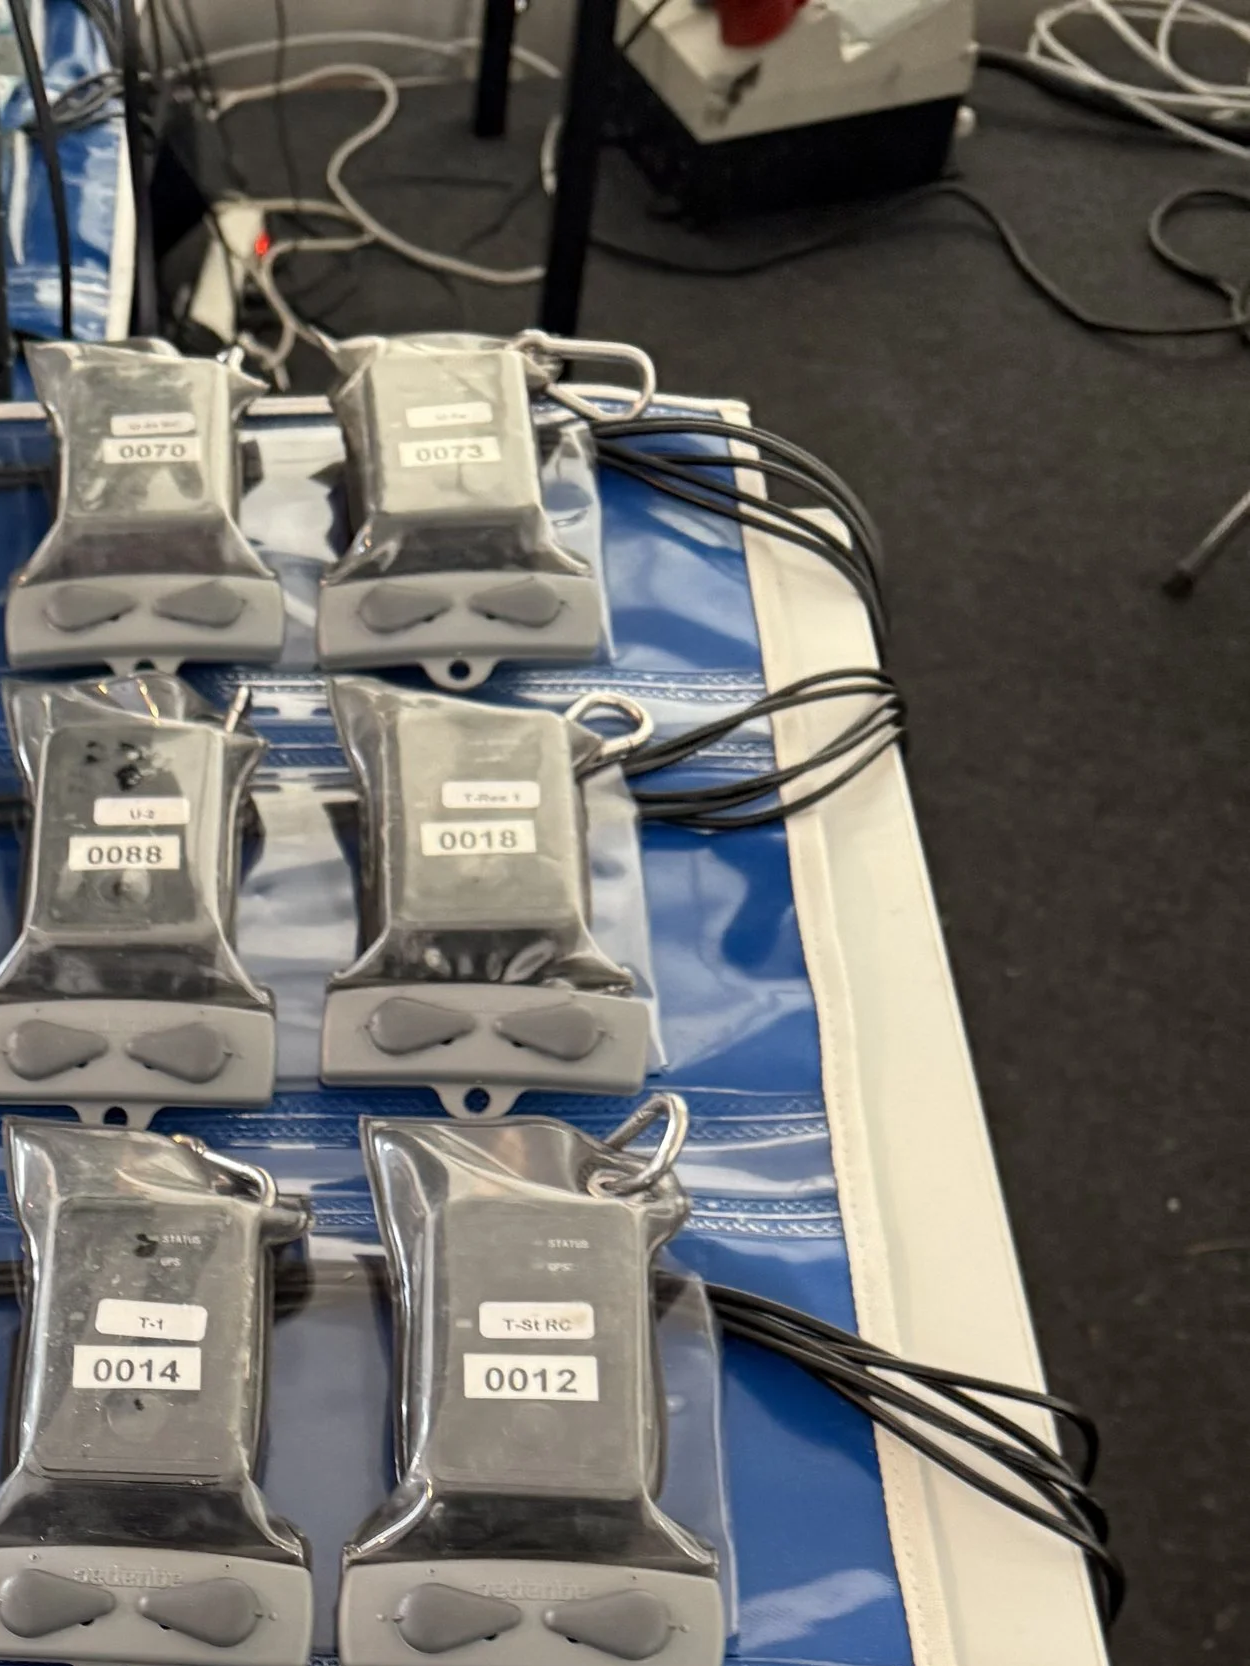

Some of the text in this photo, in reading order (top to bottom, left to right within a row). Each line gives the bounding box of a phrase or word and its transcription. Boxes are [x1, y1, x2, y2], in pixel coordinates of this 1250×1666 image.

[119, 443, 187, 459] 0070
[415, 443, 485, 463] 0073
[439, 829, 518, 851] 0018
[87, 845, 163, 865] 0088
[138, 1315, 164, 1330] T-1
[502, 1318, 539, 1331] T-St
[93, 1357, 181, 1383] 0014
[484, 1366, 578, 1394] 0012
